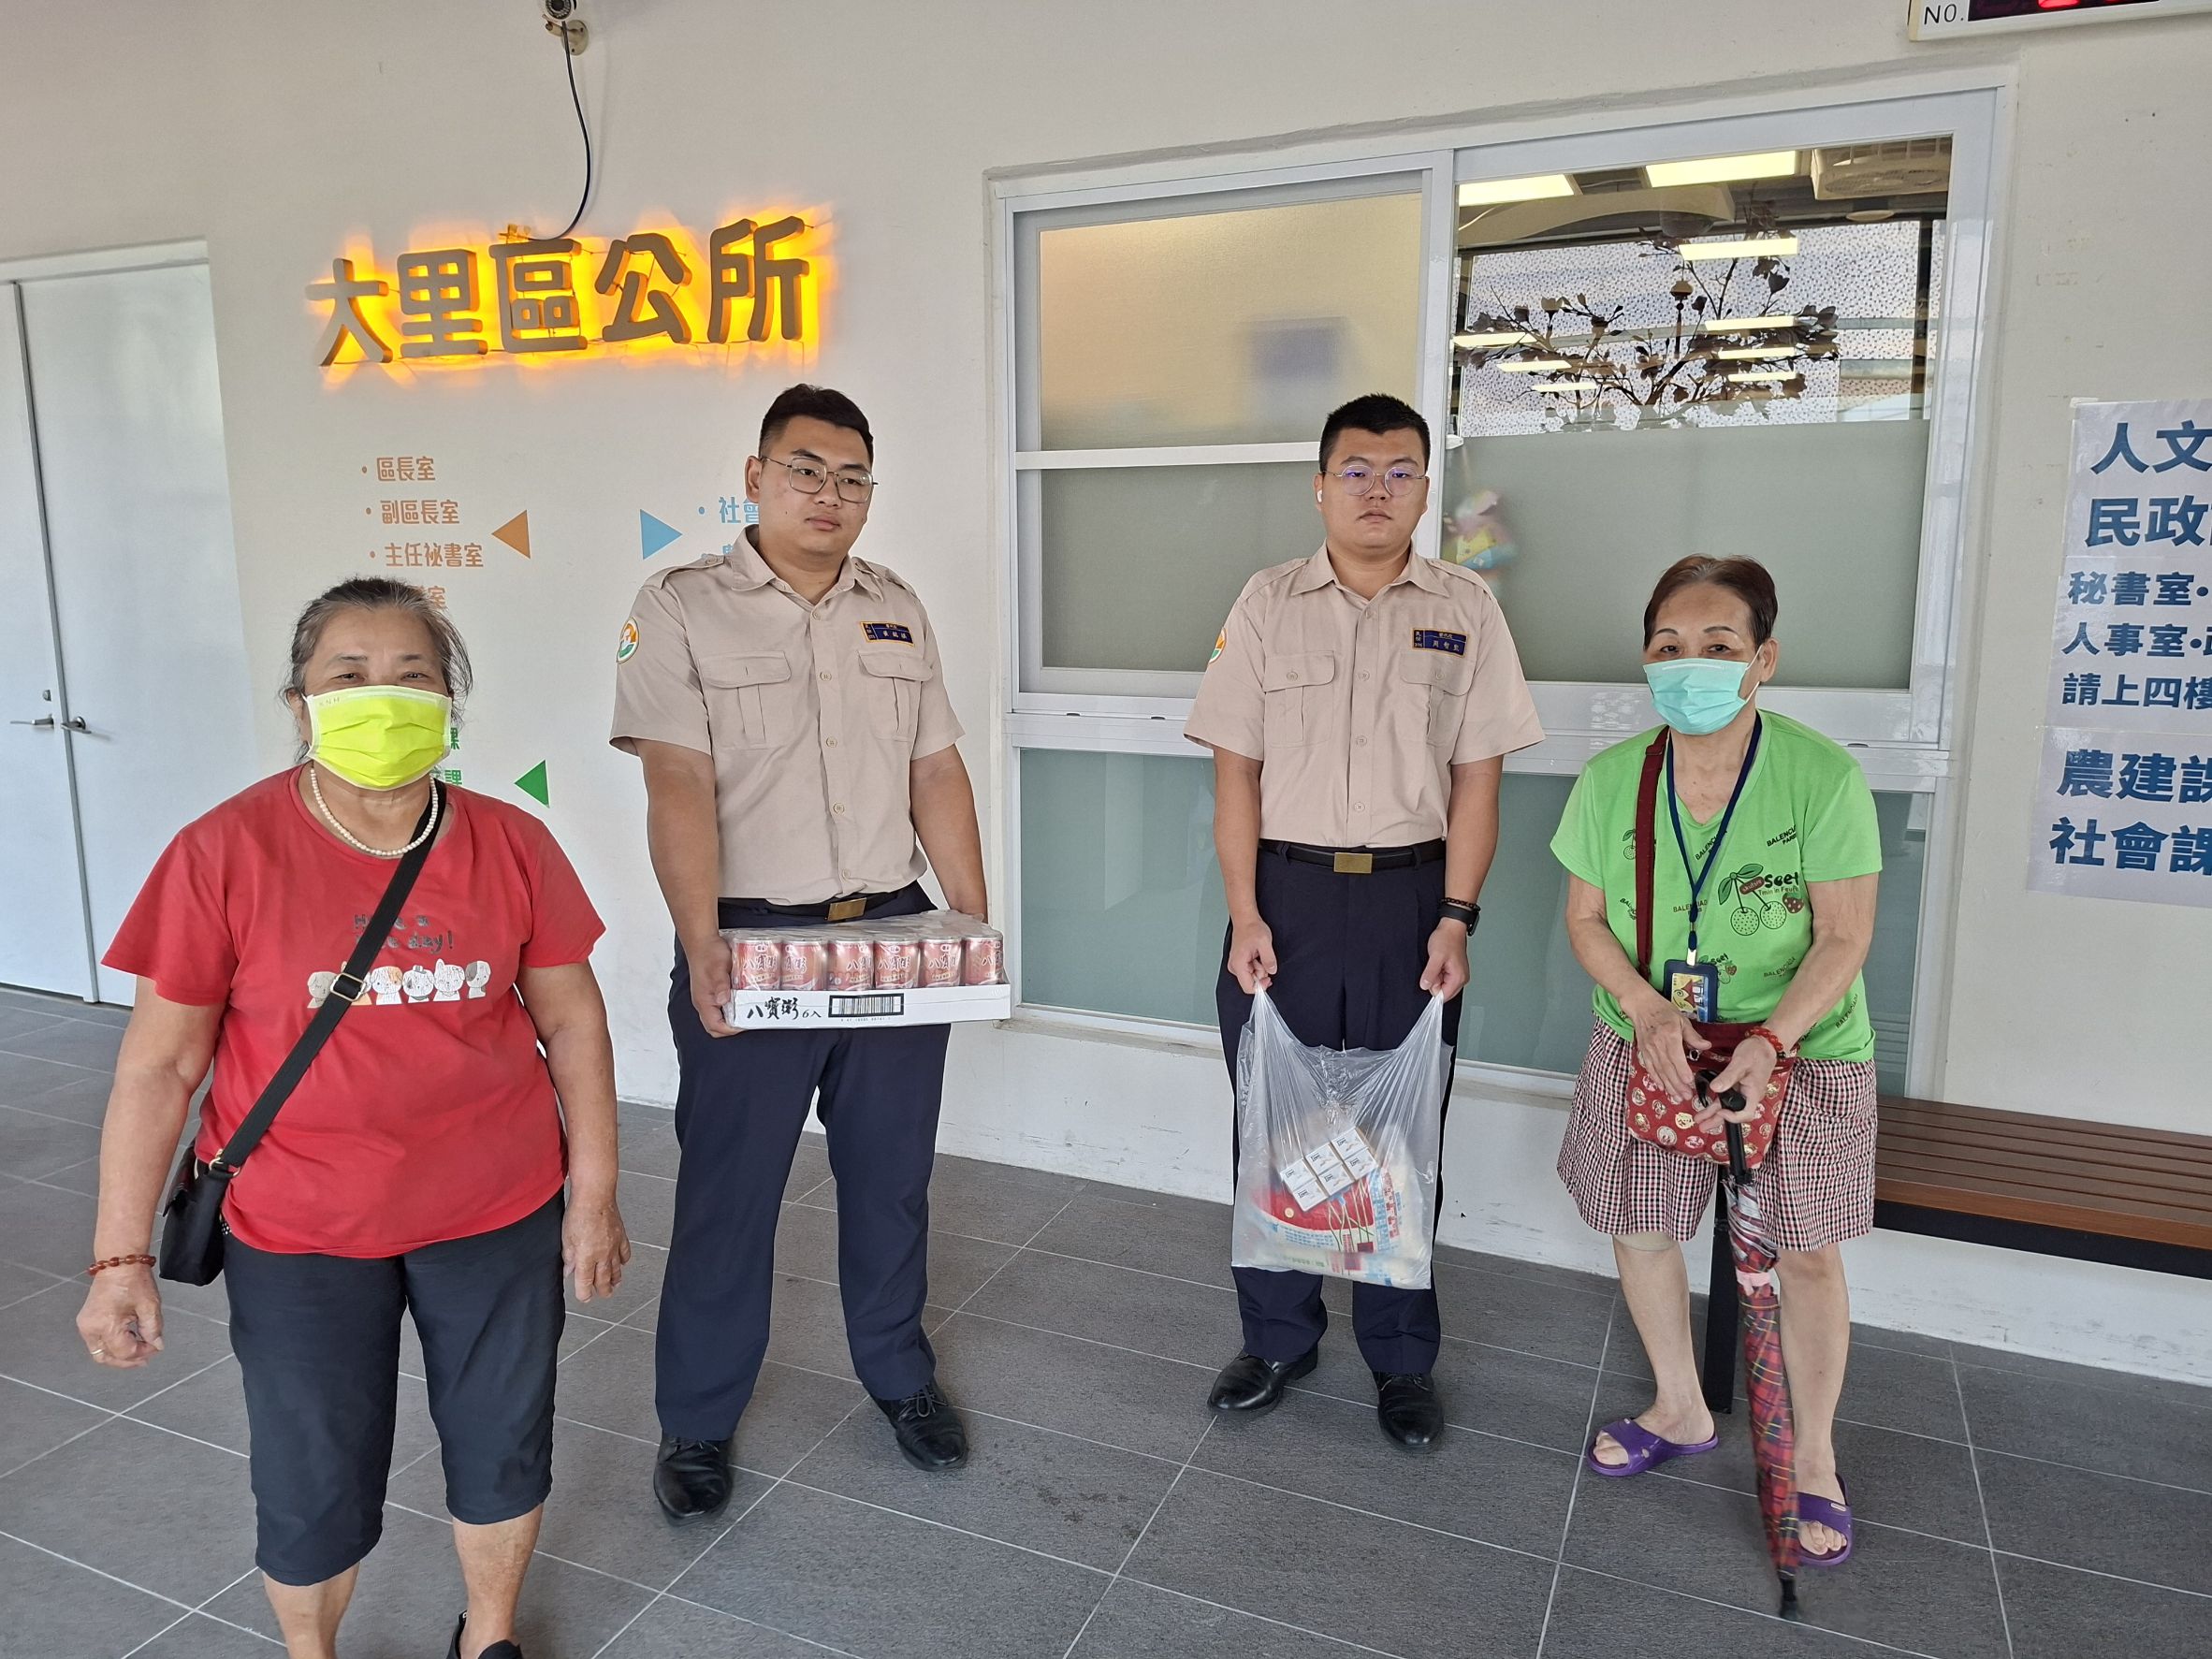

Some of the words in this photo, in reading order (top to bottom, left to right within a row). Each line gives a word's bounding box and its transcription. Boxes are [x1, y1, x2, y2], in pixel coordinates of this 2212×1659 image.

[1924, 4, 1964, 25] NO.
[305, 214, 810, 366] 大里區公所
[2089, 419, 2212, 475] 人文
[376, 456, 436, 482] 區長室
[380, 499, 460, 525] 副區長室
[2085, 494, 2212, 547] 民政
[2061, 672, 2212, 710] 請上四樓
[2049, 816, 2212, 876] 社會課
[747, 996, 799, 1021] 八寶粥
